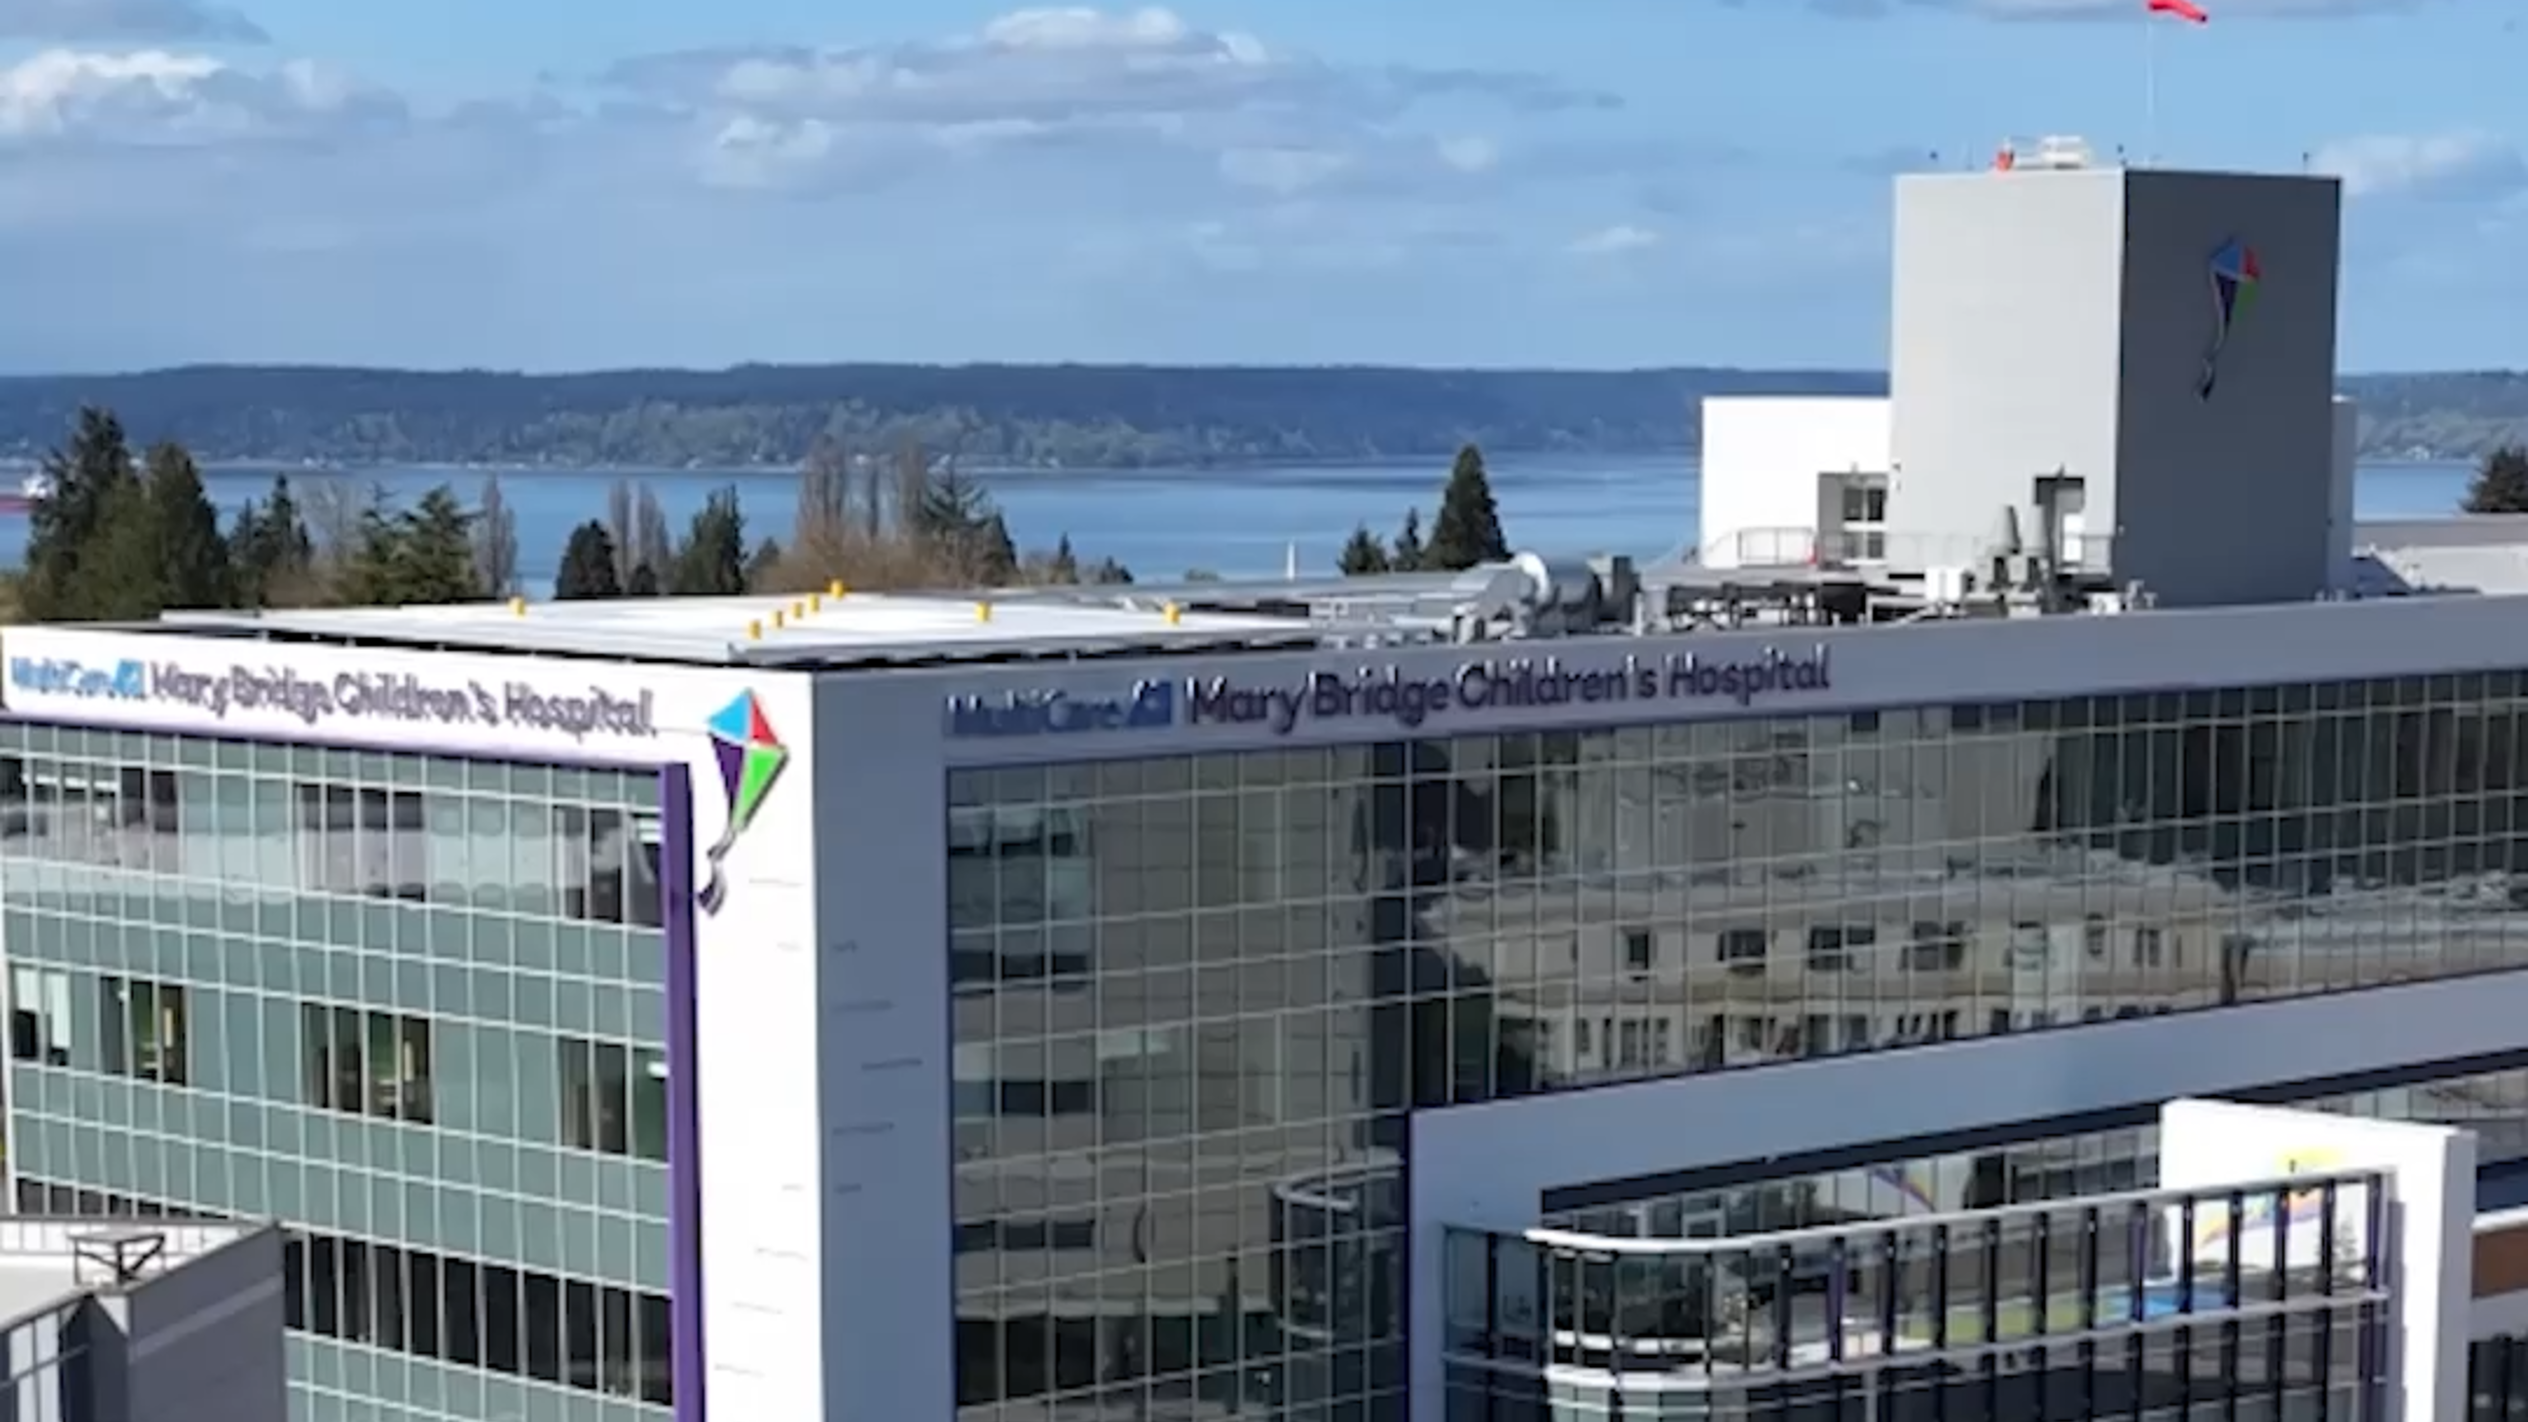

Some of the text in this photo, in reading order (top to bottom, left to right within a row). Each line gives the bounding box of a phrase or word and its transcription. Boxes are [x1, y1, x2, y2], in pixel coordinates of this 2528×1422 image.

[150, 660, 229, 718] Mary
[230, 665, 332, 723] Bridge
[334, 671, 499, 726] Children's
[504, 681, 653, 743] Hospital
[1185, 676, 1302, 735] Mary
[1306, 667, 1450, 727] Bridge
[1455, 651, 1658, 708] Children's
[1667, 643, 1831, 704] Hospital
